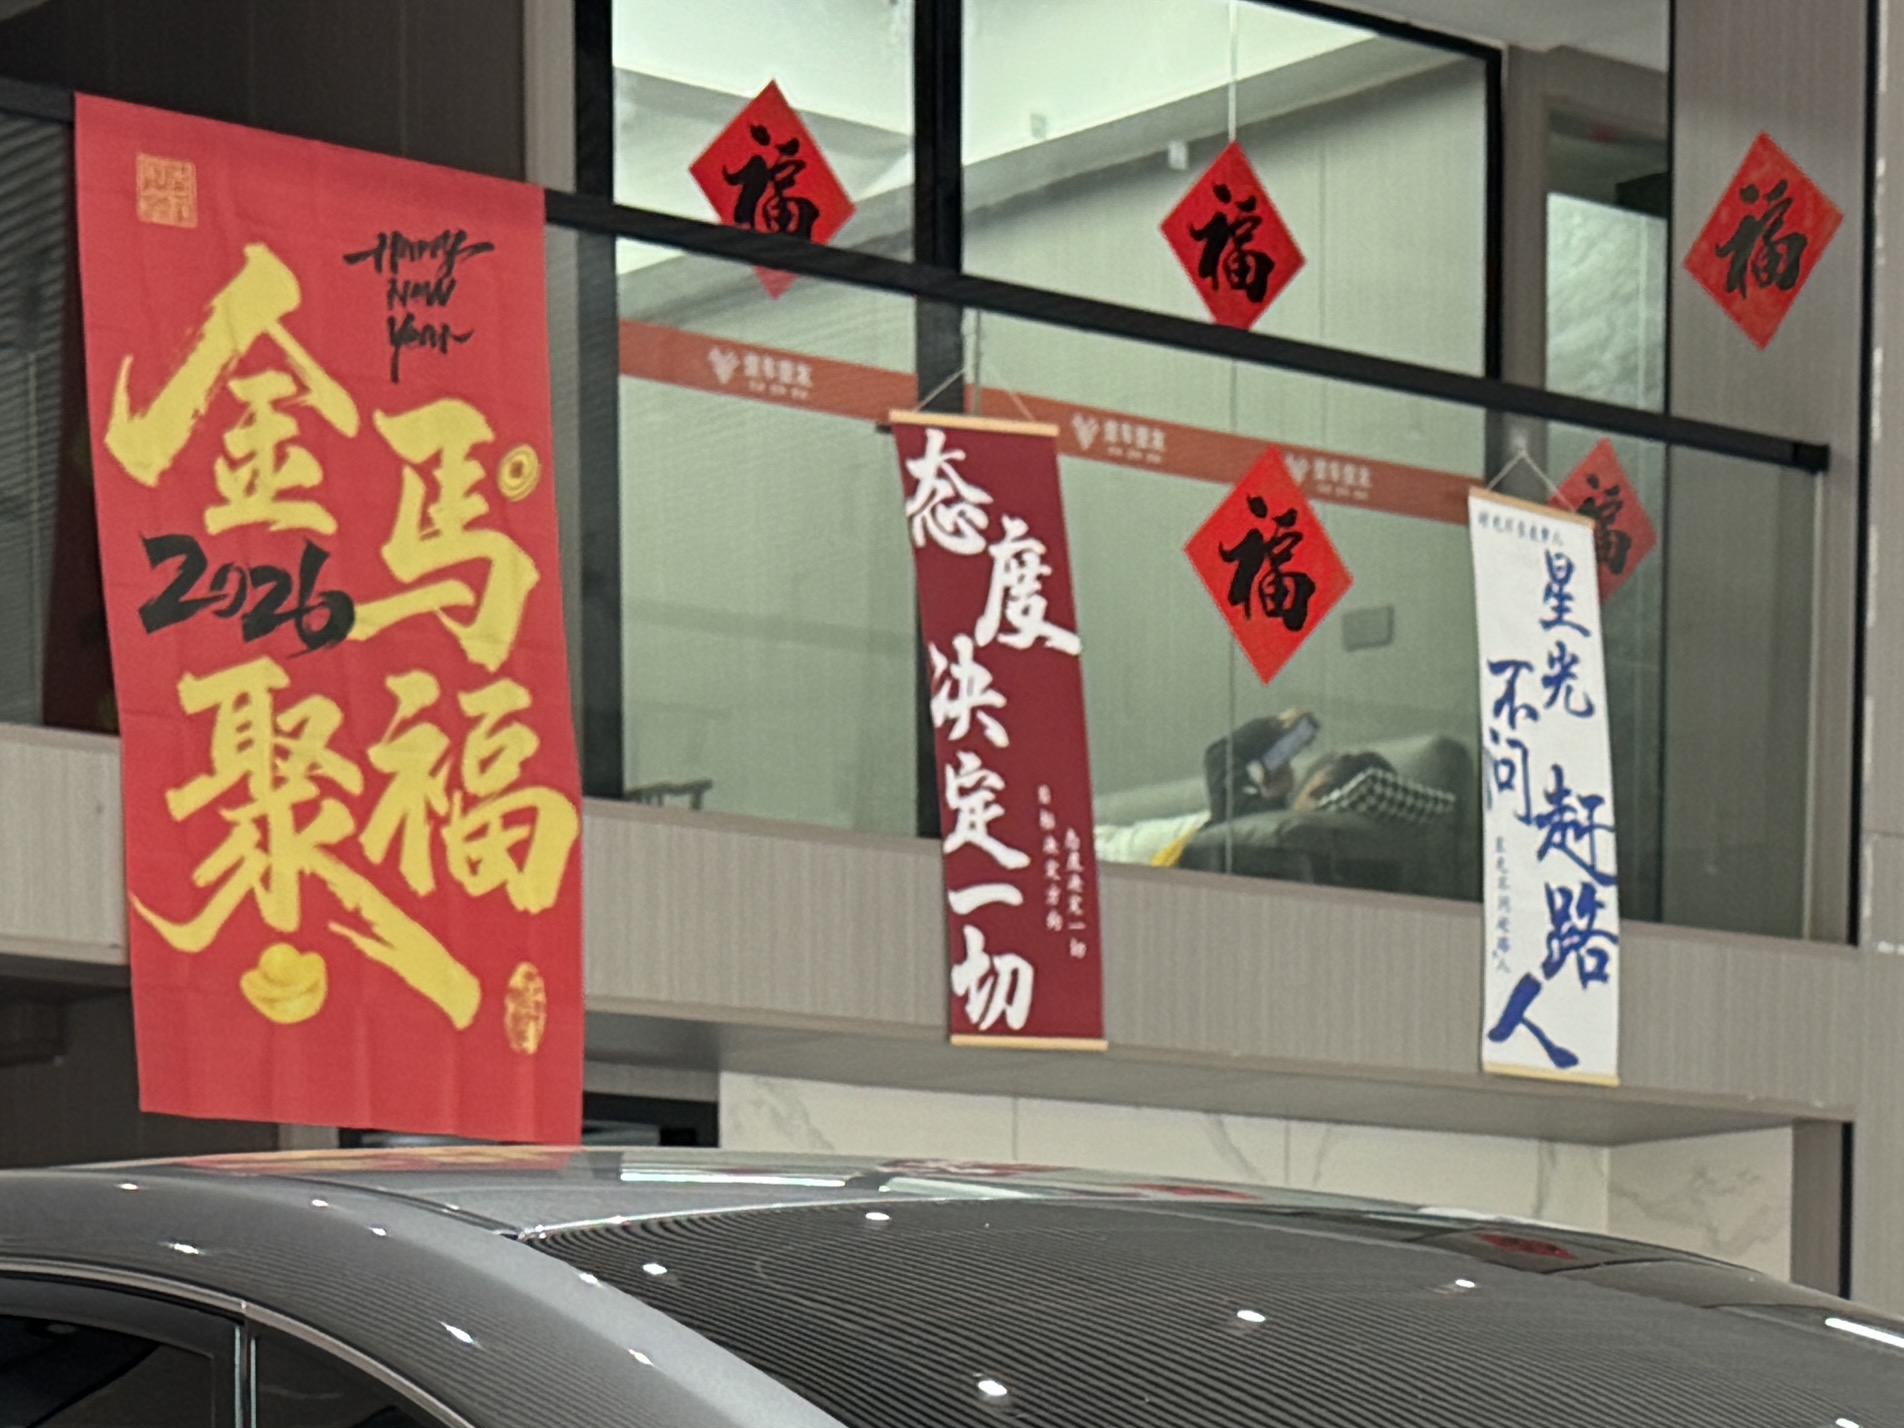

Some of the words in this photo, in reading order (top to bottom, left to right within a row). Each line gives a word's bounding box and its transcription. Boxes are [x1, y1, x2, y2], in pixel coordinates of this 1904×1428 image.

[723, 124, 821, 241] 福
[1190, 184, 1274, 302] 福
[1715, 179, 1808, 299] 福
[138, 531, 356, 659] 2026
[1218, 496, 1316, 632] 福
[904, 428, 1082, 1031] 态度决定一切
[129, 656, 581, 1032] 聚福
